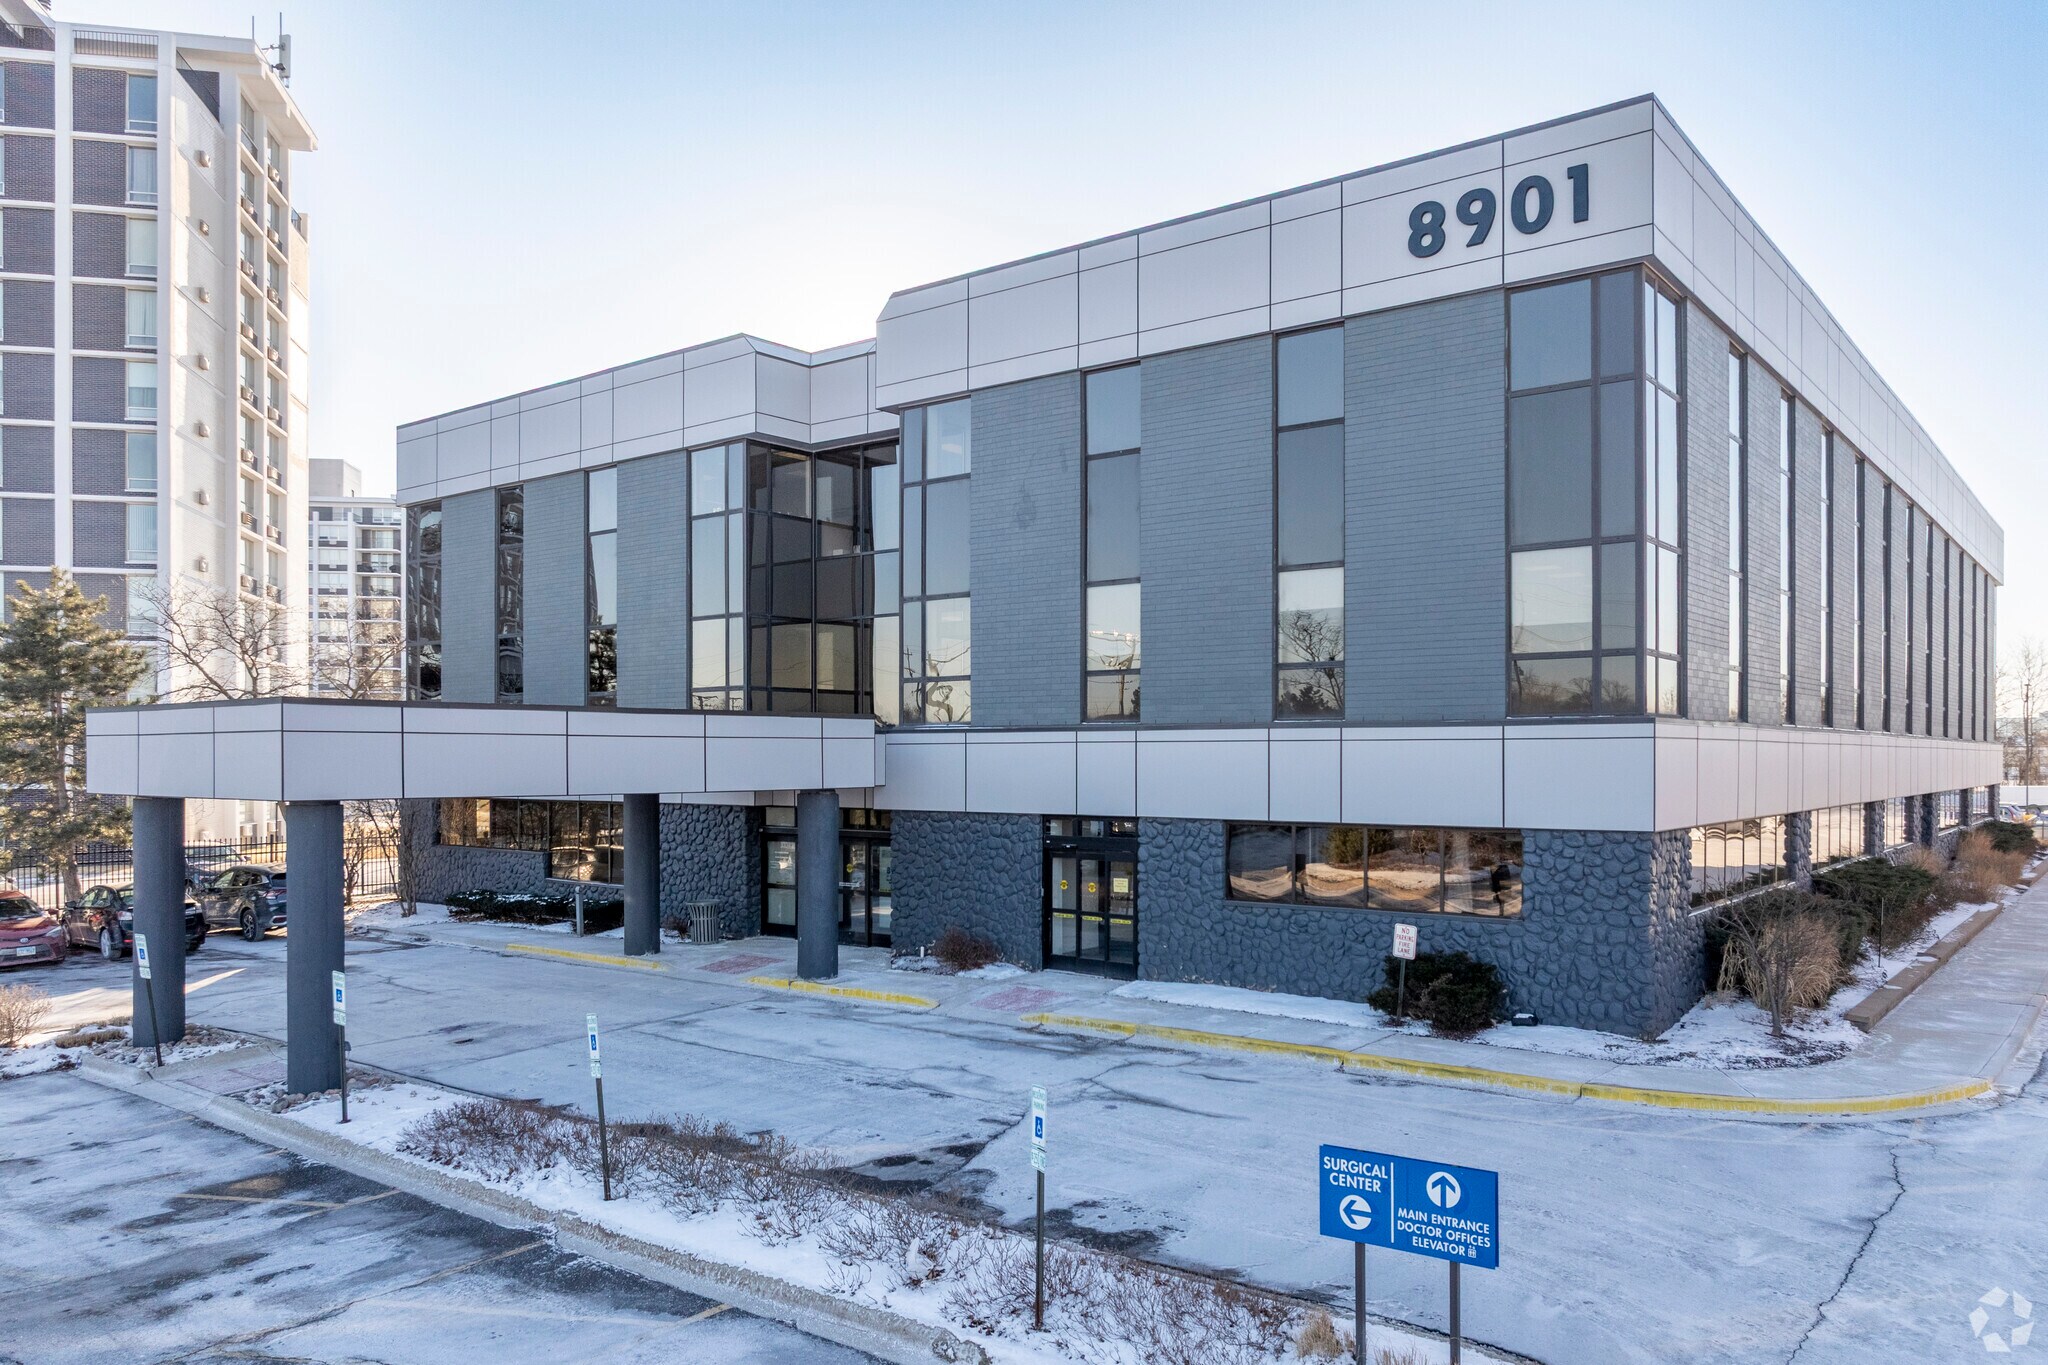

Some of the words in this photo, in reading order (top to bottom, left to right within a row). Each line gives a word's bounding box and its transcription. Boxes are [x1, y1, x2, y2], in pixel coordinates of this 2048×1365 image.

[1408, 163, 1589, 259] 8901
[1396, 934, 1415, 943] PARKING
[1398, 941, 1411, 949] FIRE
[1398, 947, 1411, 955] LANE
[1323, 1156, 1388, 1179] SURGICAL
[1329, 1172, 1381, 1193] CENTER
[1398, 1207, 1428, 1223] MAIN
[1431, 1213, 1490, 1235] ENTRANCE
[1397, 1220, 1442, 1238] DOCTOR
[1445, 1229, 1491, 1248] OFFICES
[1412, 1236, 1466, 1257] ELEVATOR
